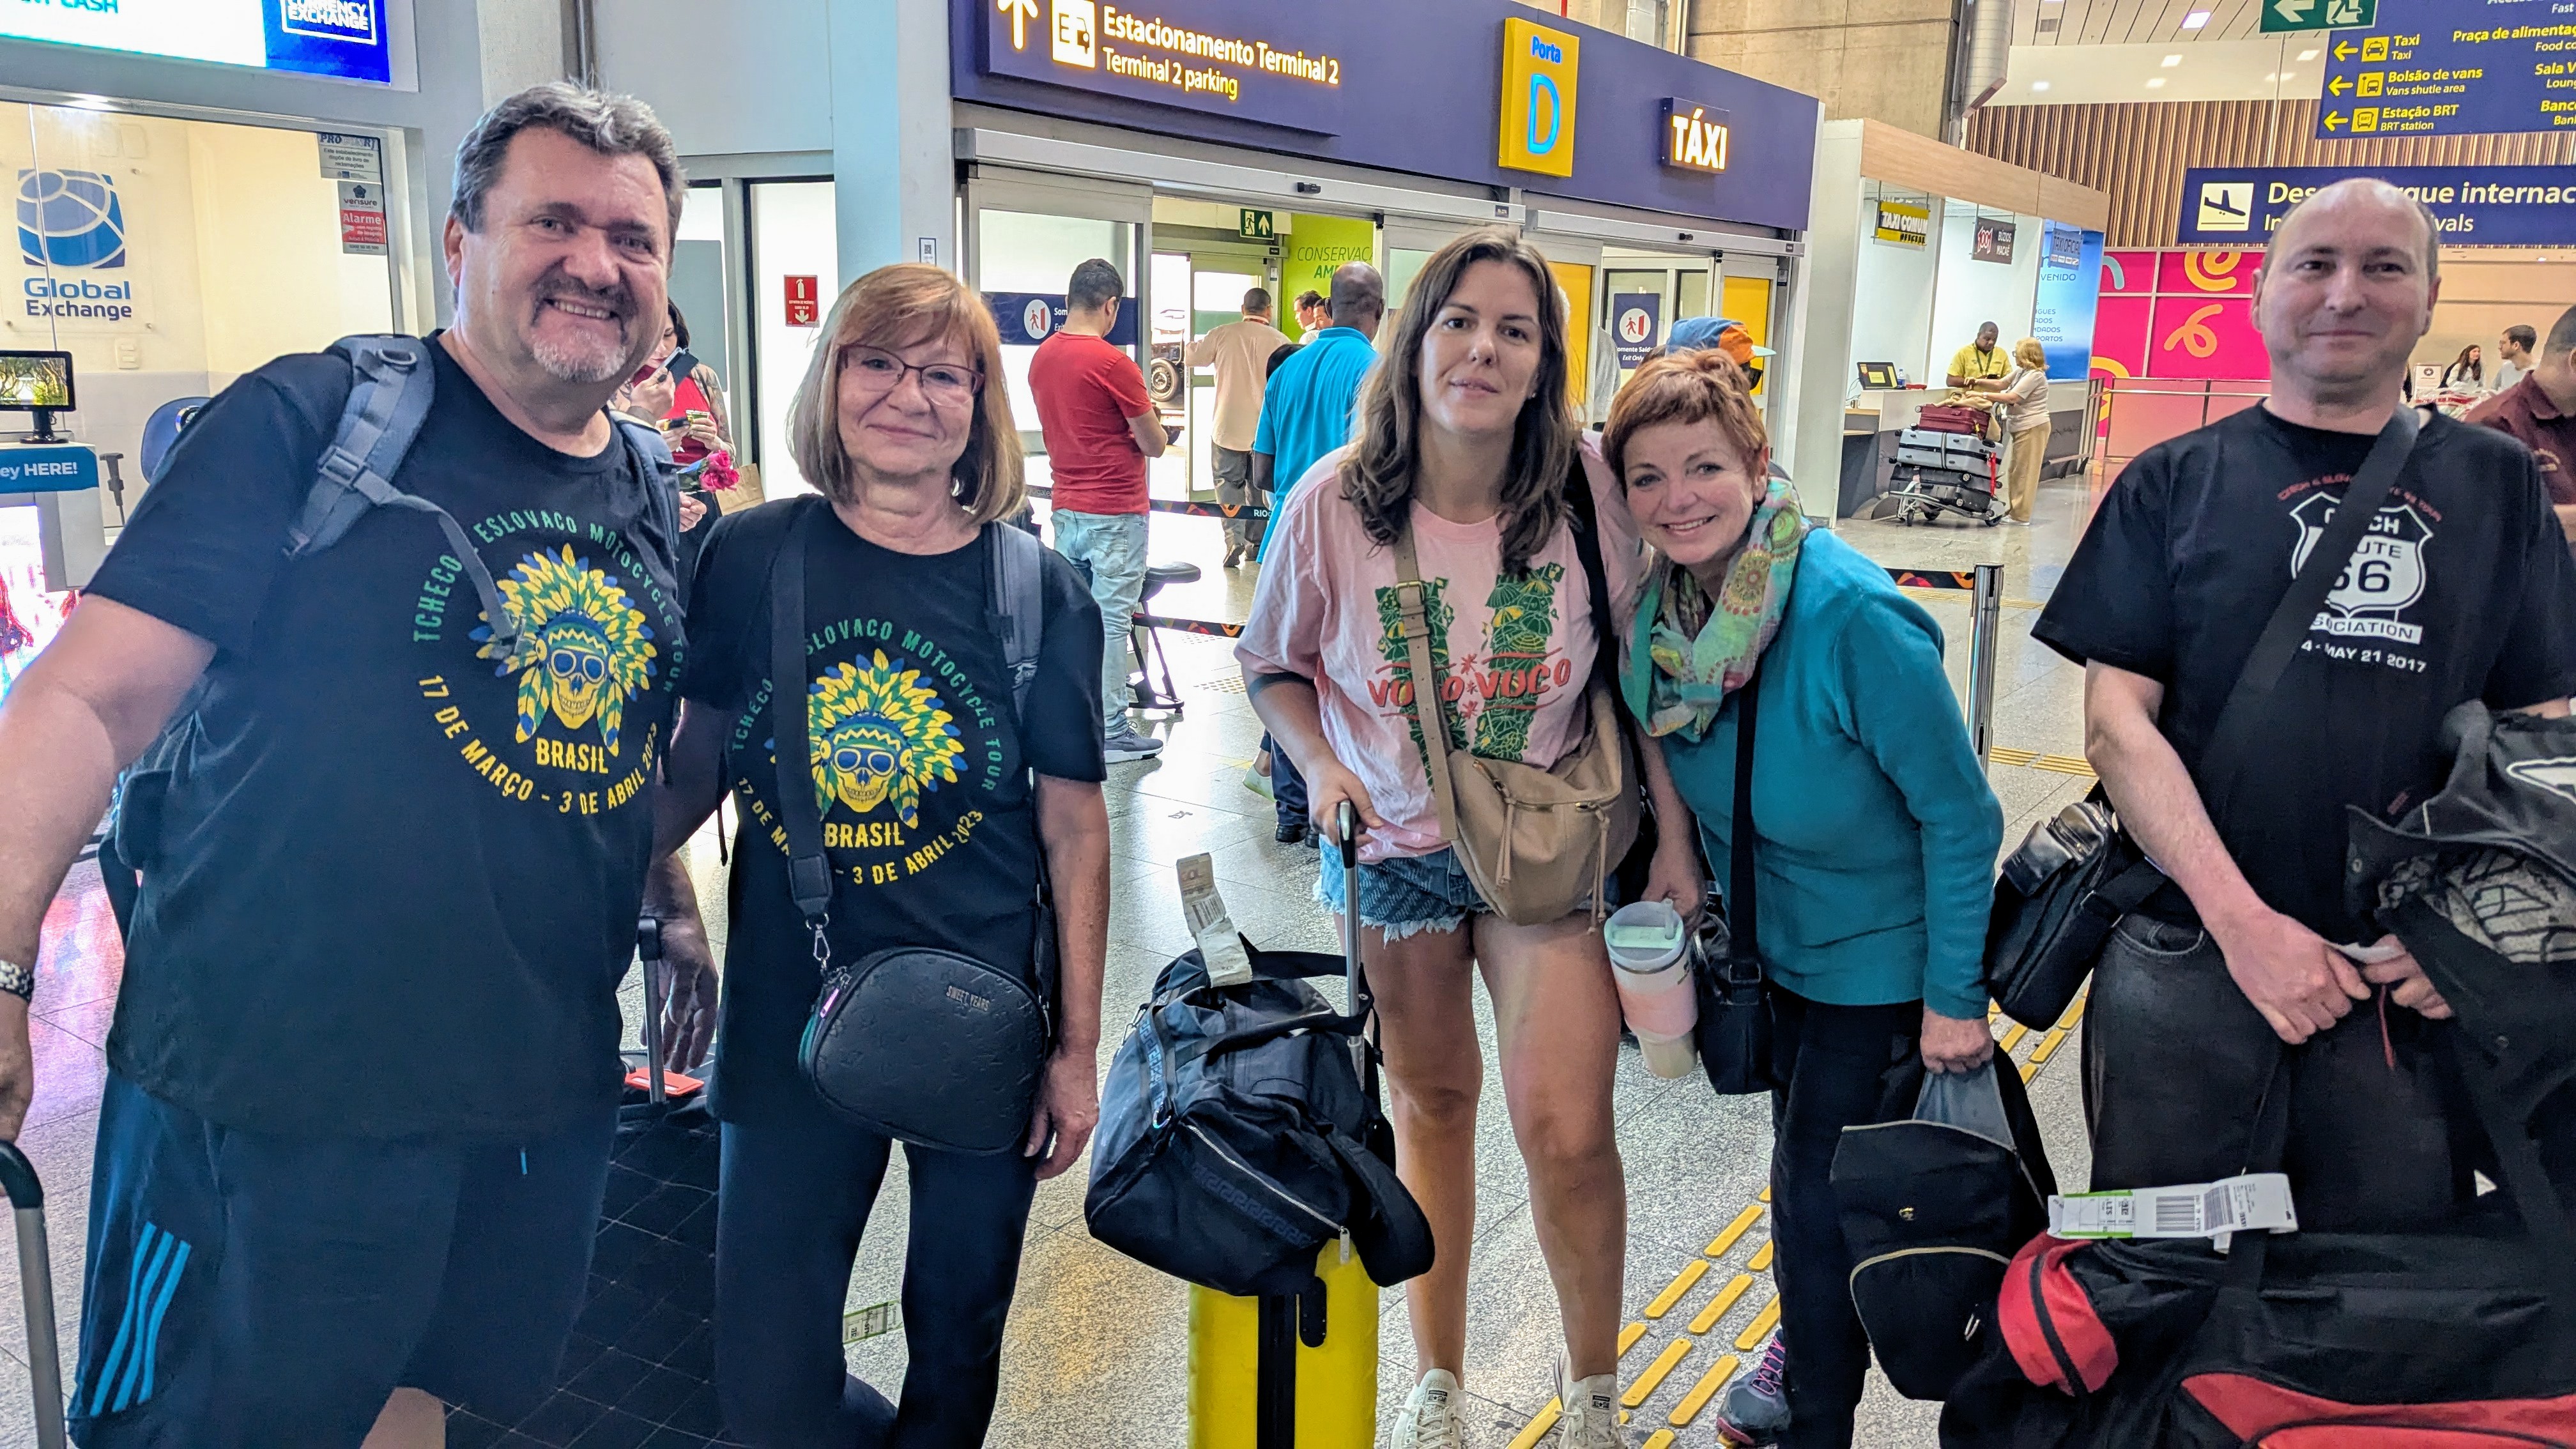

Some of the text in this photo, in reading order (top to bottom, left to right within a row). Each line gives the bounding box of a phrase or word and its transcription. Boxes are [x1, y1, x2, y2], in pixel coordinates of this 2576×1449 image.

[289, 4, 369, 31] EXCHANGE
[2552, 3, 2574, 13] Fast
[1103, 5, 1339, 84] Estacionamento Terminal 2
[2394, 34, 2420, 47] Taxi
[2453, 31, 2489, 43] Praça
[2492, 27, 2509, 40] de
[2535, 40, 2564, 52] Food
[1531, 36, 1562, 64] Porta
[2391, 51, 2412, 61] Taxi
[1103, 47, 1238, 100] Terminal 2 parking
[2388, 68, 2483, 83] Bolsão de vans
[2534, 62, 2564, 75] Sala
[2386, 84, 2465, 96] Vans shutle area
[1528, 73, 1560, 154] D
[2382, 104, 2460, 120] Estação BRT
[2380, 121, 2434, 131] BRT station
[1672, 108, 1728, 170] TÁXI
[343, 213, 381, 225] Alarme
[1882, 211, 1928, 234] TAXI COMUM
[1977, 226, 1993, 254] 1001
[24, 277, 131, 300] Global
[26, 299, 132, 321] Exchange
[24, 461, 78, 476] HERE!
[2356, 542, 2402, 559] UTE
[413, 555, 463, 642] TCHECO
[473, 509, 578, 544] ESLOVACO
[590, 523, 674, 627] MOTOCYCLE
[2313, 616, 2413, 640] SOCIATION
[2324, 642, 2358, 660] MAY
[2361, 649, 2382, 663] 21
[2386, 653, 2427, 673] 2017
[732, 678, 774, 751] TCHECO
[901, 629, 995, 728] MOTOCYCLE
[981, 738, 1002, 791] TOUR
[418, 675, 450, 698] 17
[434, 705, 470, 740] DE
[461, 738, 534, 801] MARÇO
[558, 791, 573, 813] 3
[579, 792, 599, 815] DE
[607, 767, 646, 810] ABRIL
[535, 737, 609, 775] BRASIL
[738, 777, 774, 827] 17 DE
[824, 822, 905, 848] BRASIL
[852, 866, 863, 884] 3
[871, 862, 898, 885] DE
[905, 834, 954, 875] ABRIL
[951, 810, 984, 844] 2023
[946, 985, 990, 1011] SWEET YEARS
